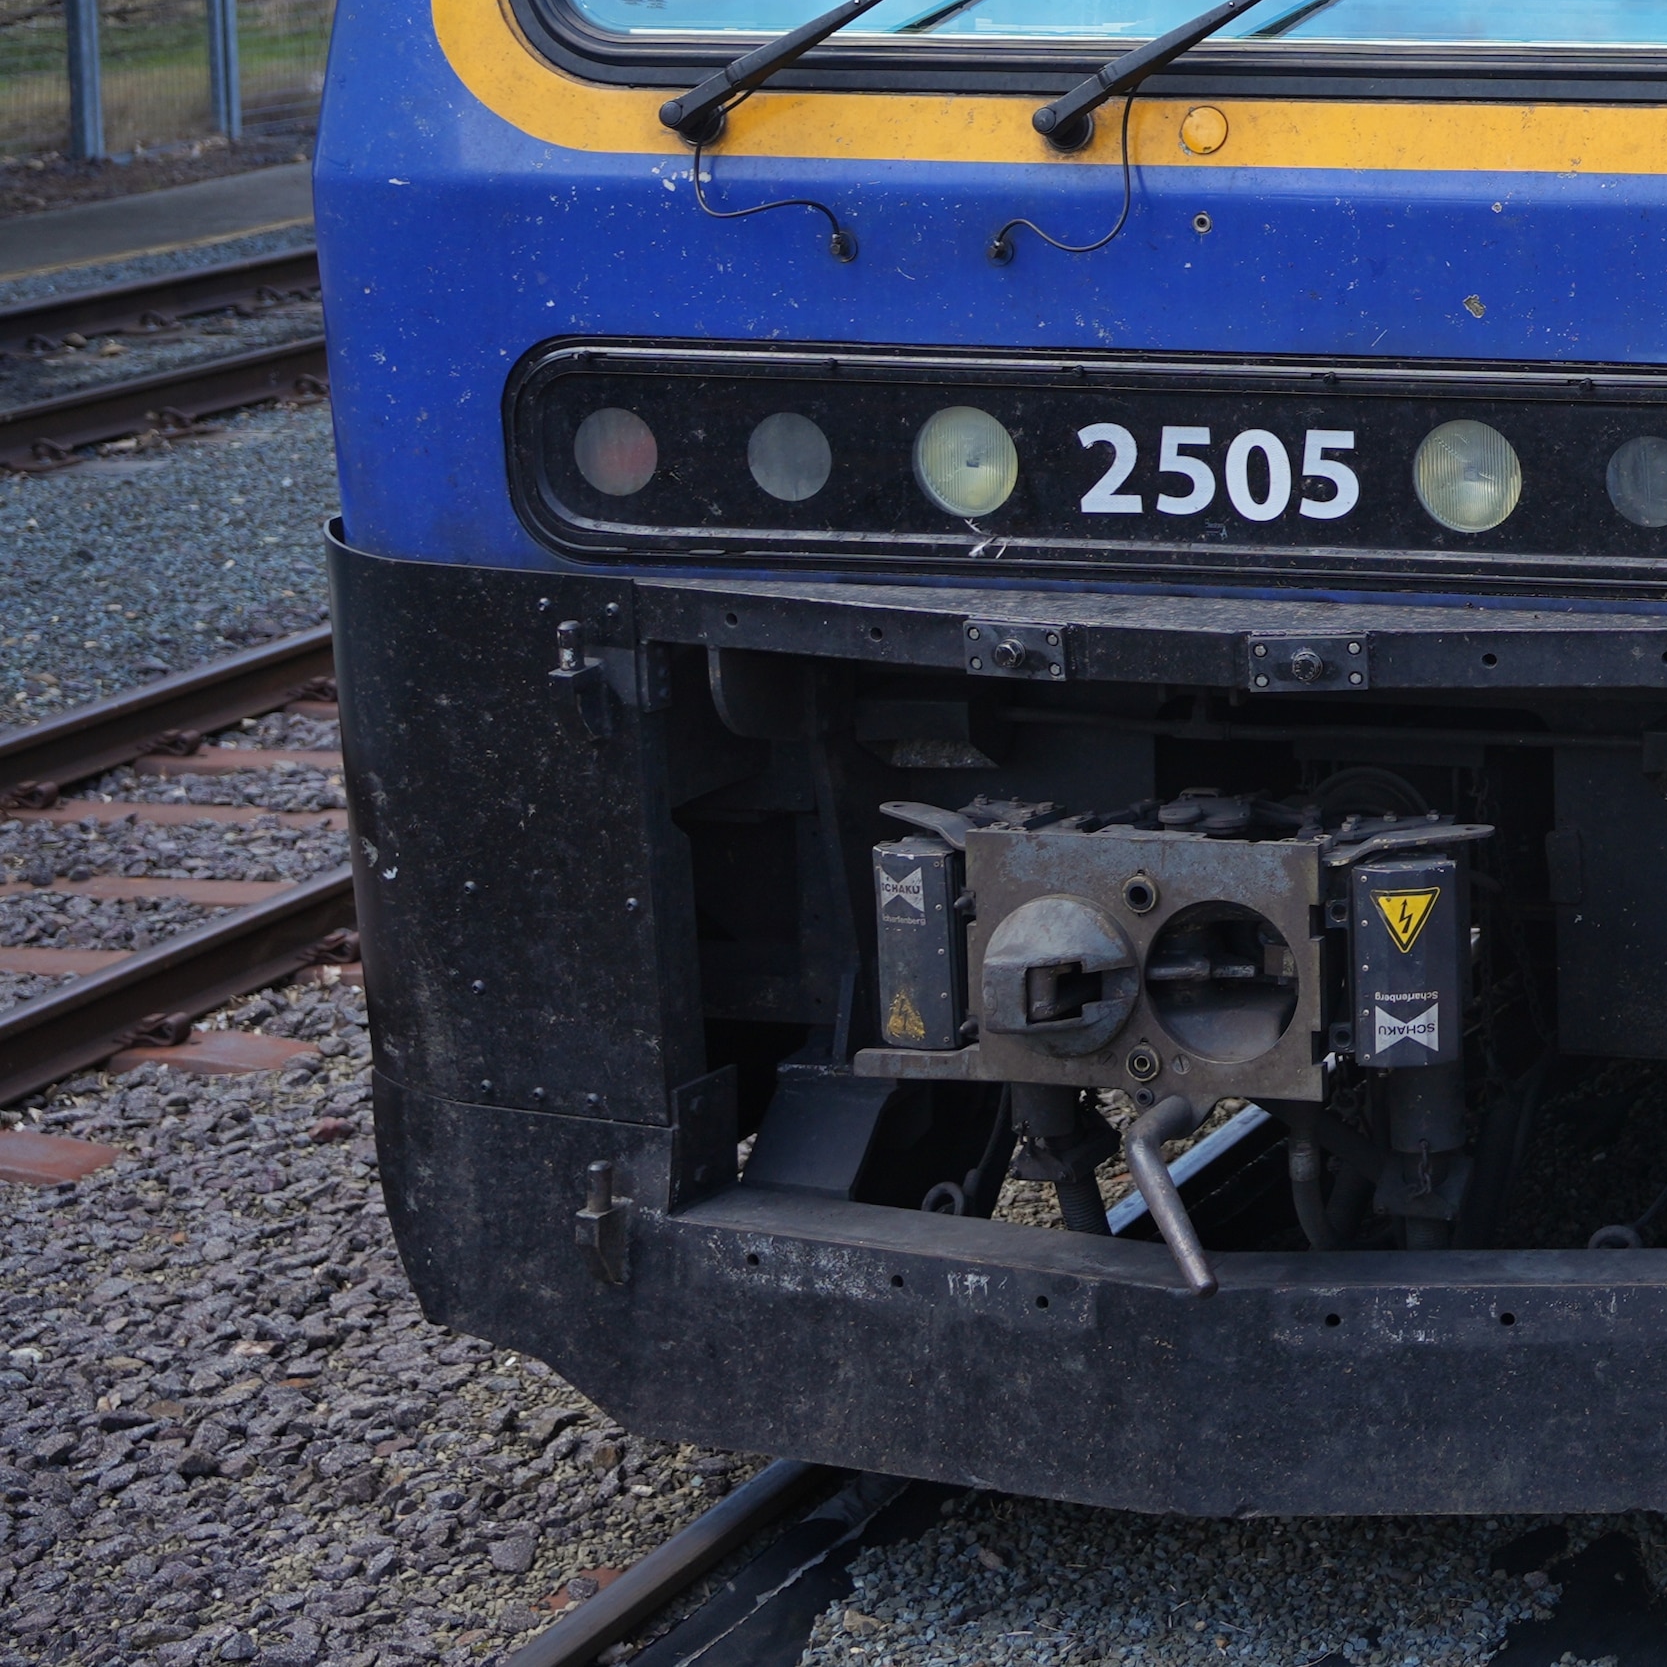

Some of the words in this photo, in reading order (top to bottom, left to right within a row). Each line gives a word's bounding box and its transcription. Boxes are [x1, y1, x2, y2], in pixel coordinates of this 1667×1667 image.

[1077, 422, 1360, 522] 2505
[1374, 990, 1439, 1003] Scharfenberg
[1378, 1022, 1436, 1036] SCHAKU
